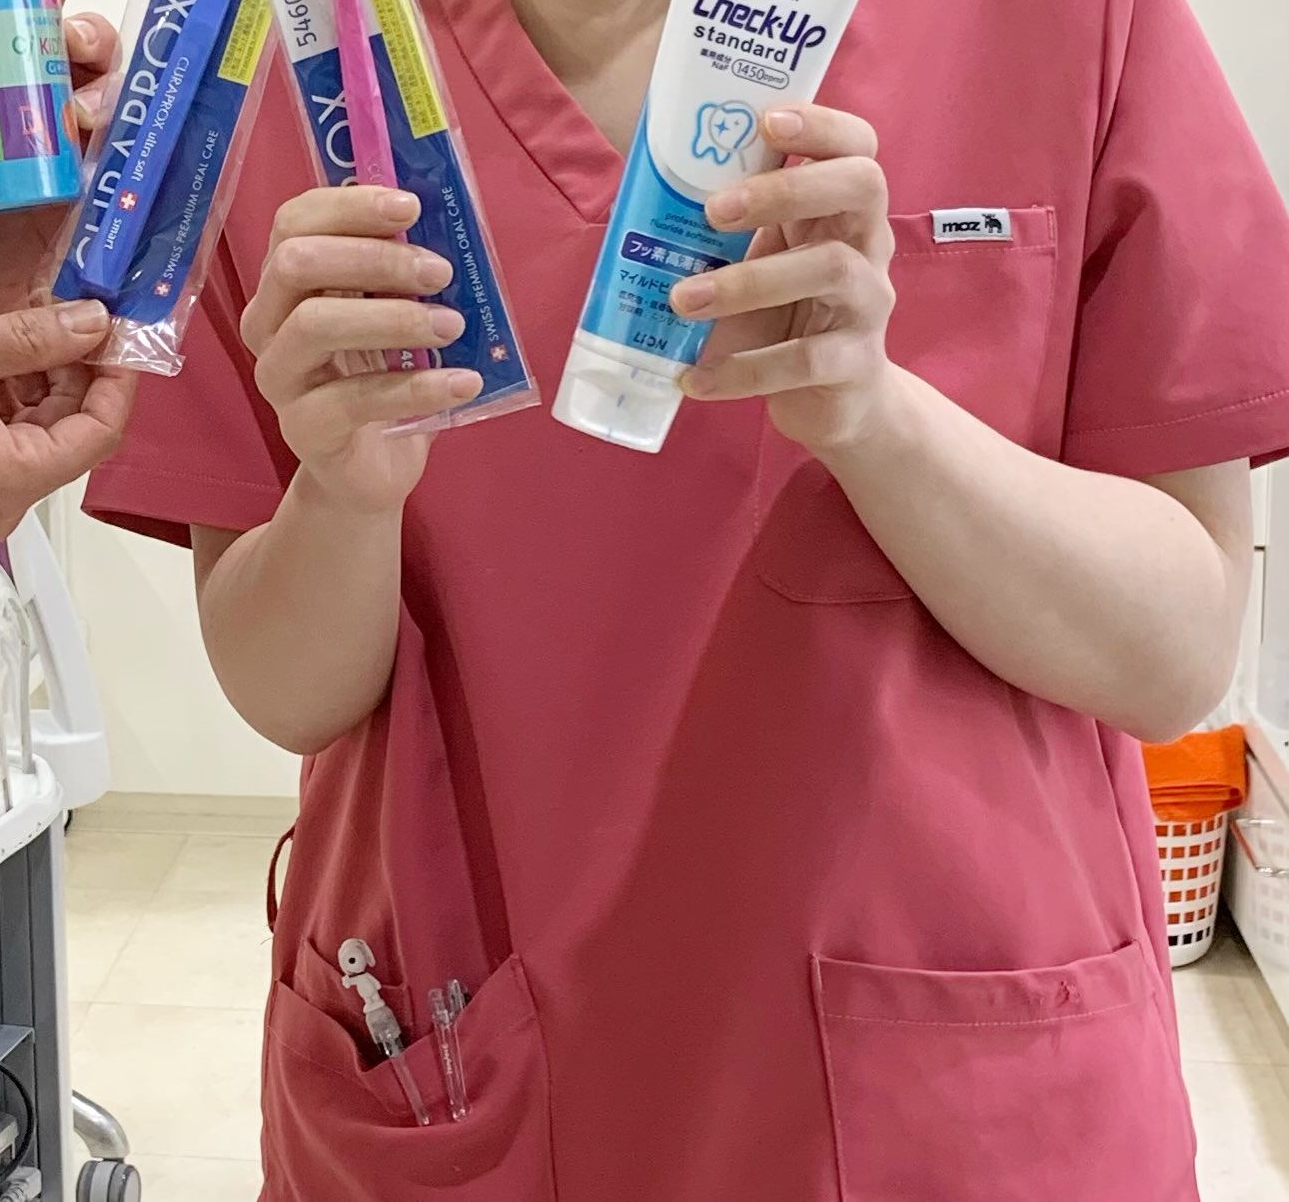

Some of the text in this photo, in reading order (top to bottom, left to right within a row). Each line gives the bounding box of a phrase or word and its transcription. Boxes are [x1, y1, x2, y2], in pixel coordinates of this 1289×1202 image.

[693, 24, 788, 64] standard
[131, 56, 189, 182] CURAPROX ultra soft
[163, 130, 219, 279] SWISS PREMIUM ORAL CARE
[104, 217, 122, 250] smart
[942, 221, 981, 233] moz
[442, 186, 499, 342] SWISS PREMIUM ORAL CARE
[633, 331, 668, 351] LION
